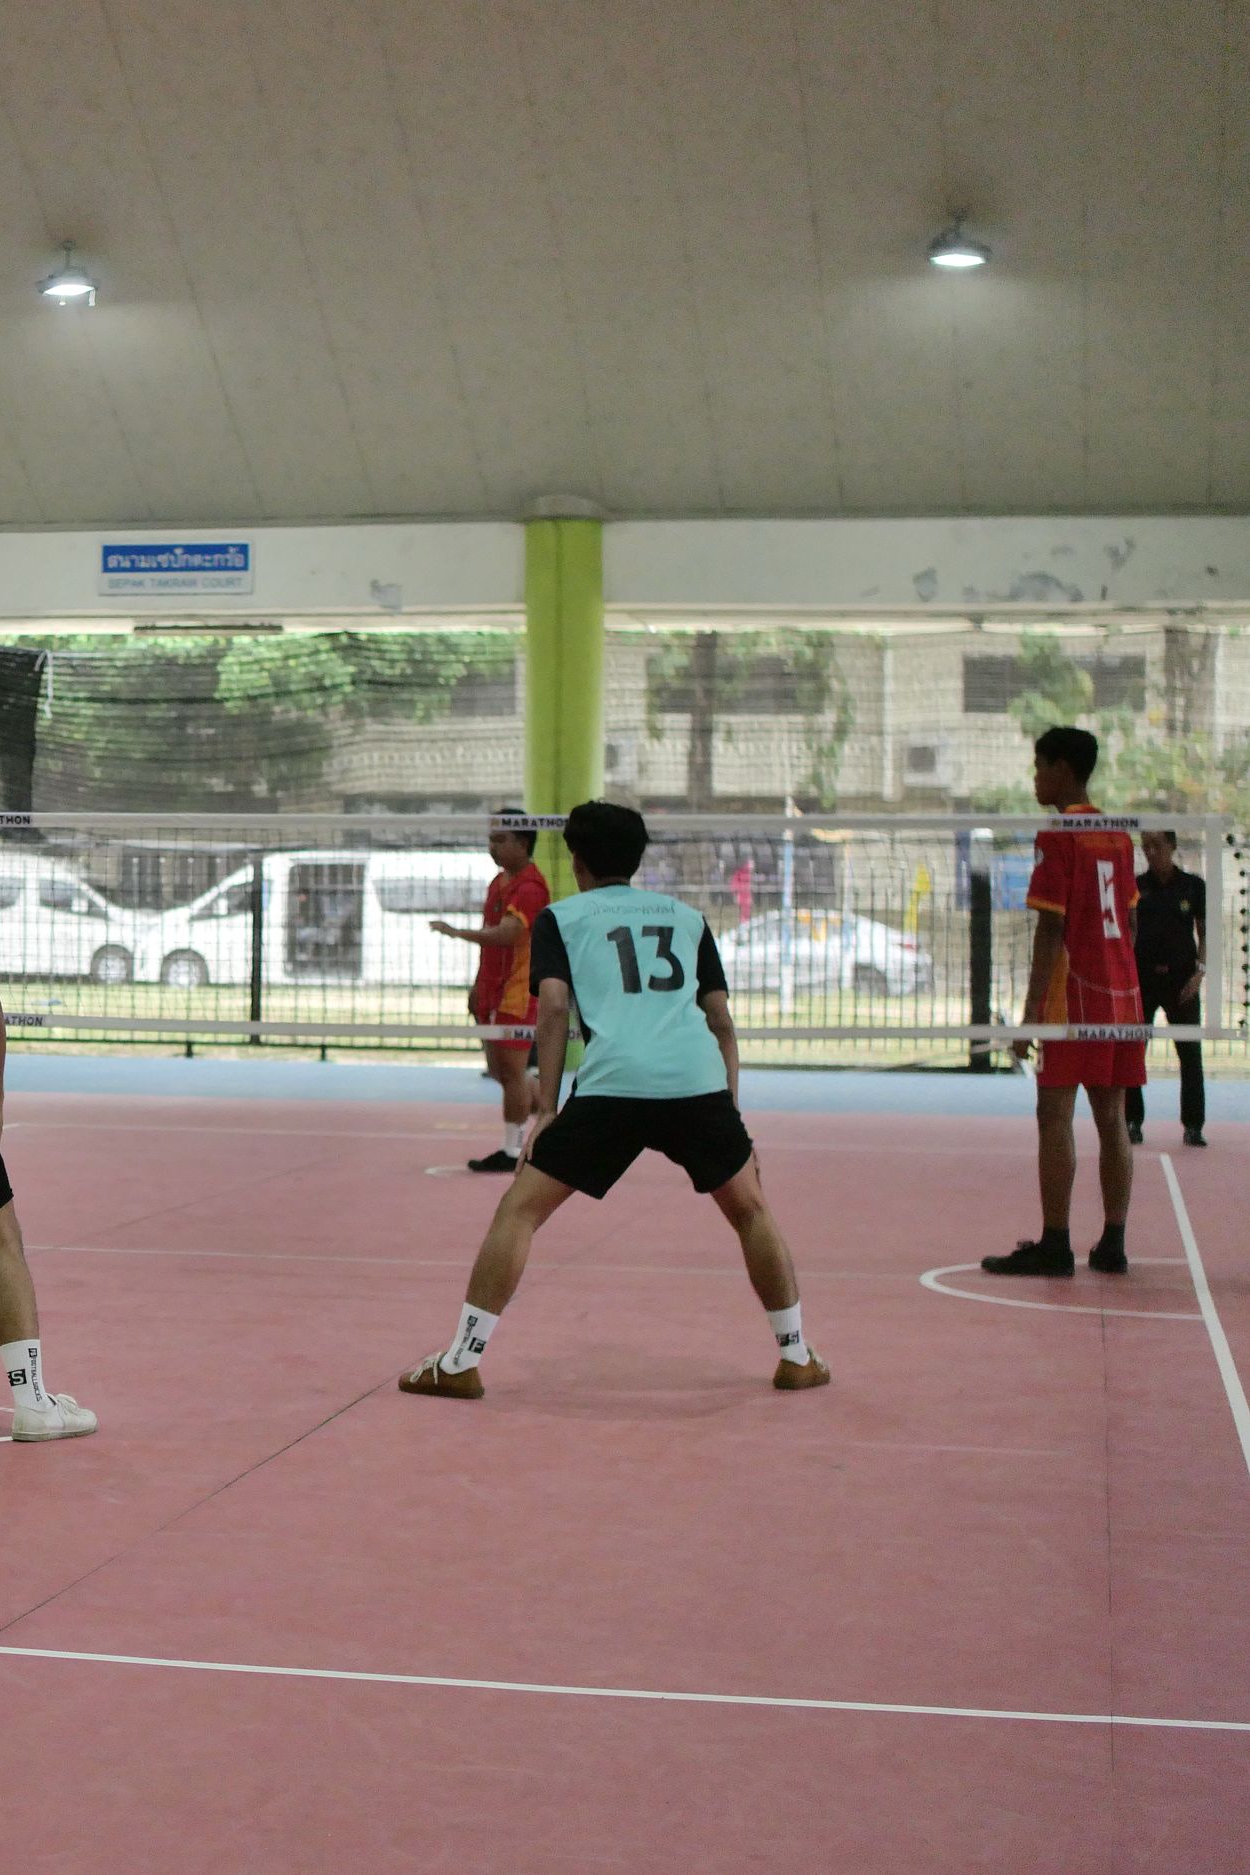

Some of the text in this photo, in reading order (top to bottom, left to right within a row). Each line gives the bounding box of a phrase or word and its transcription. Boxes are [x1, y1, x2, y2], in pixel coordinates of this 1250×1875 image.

[108, 577, 145, 590] SEPAK
[202, 577, 243, 590] COURT
[1062, 818, 1139, 828] MARATHON
[606, 925, 685, 994] 13
[4, 1015, 43, 1026] ATHON
[1078, 1027, 1154, 1040] MARATHON
